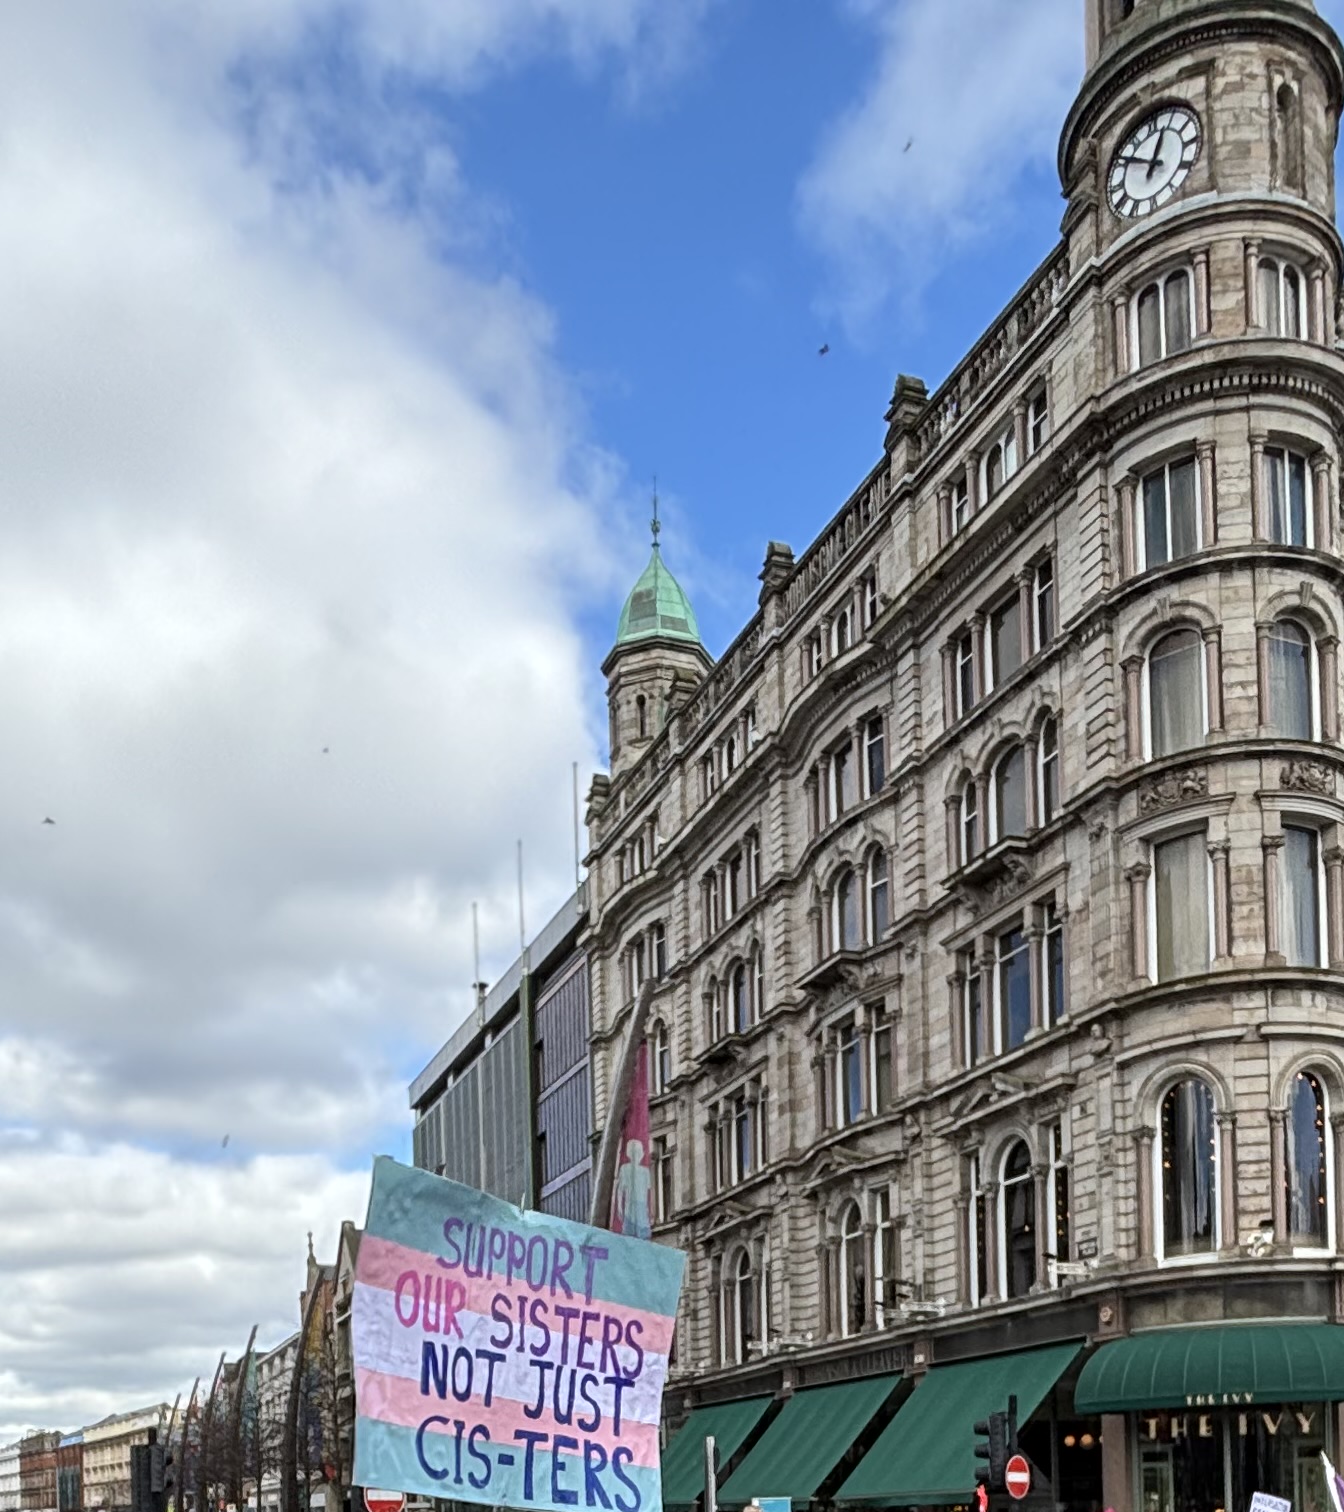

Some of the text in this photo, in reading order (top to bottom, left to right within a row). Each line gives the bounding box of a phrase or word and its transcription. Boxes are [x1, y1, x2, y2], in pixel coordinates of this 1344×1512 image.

[436, 1217, 609, 1306] SUPPORT
[394, 1271, 644, 1380] OUR SISTERS
[419, 1341, 636, 1437] NOT JUST
[1145, 1412, 1315, 1440] THE IVY
[1186, 1392, 1254, 1406] THE IVY
